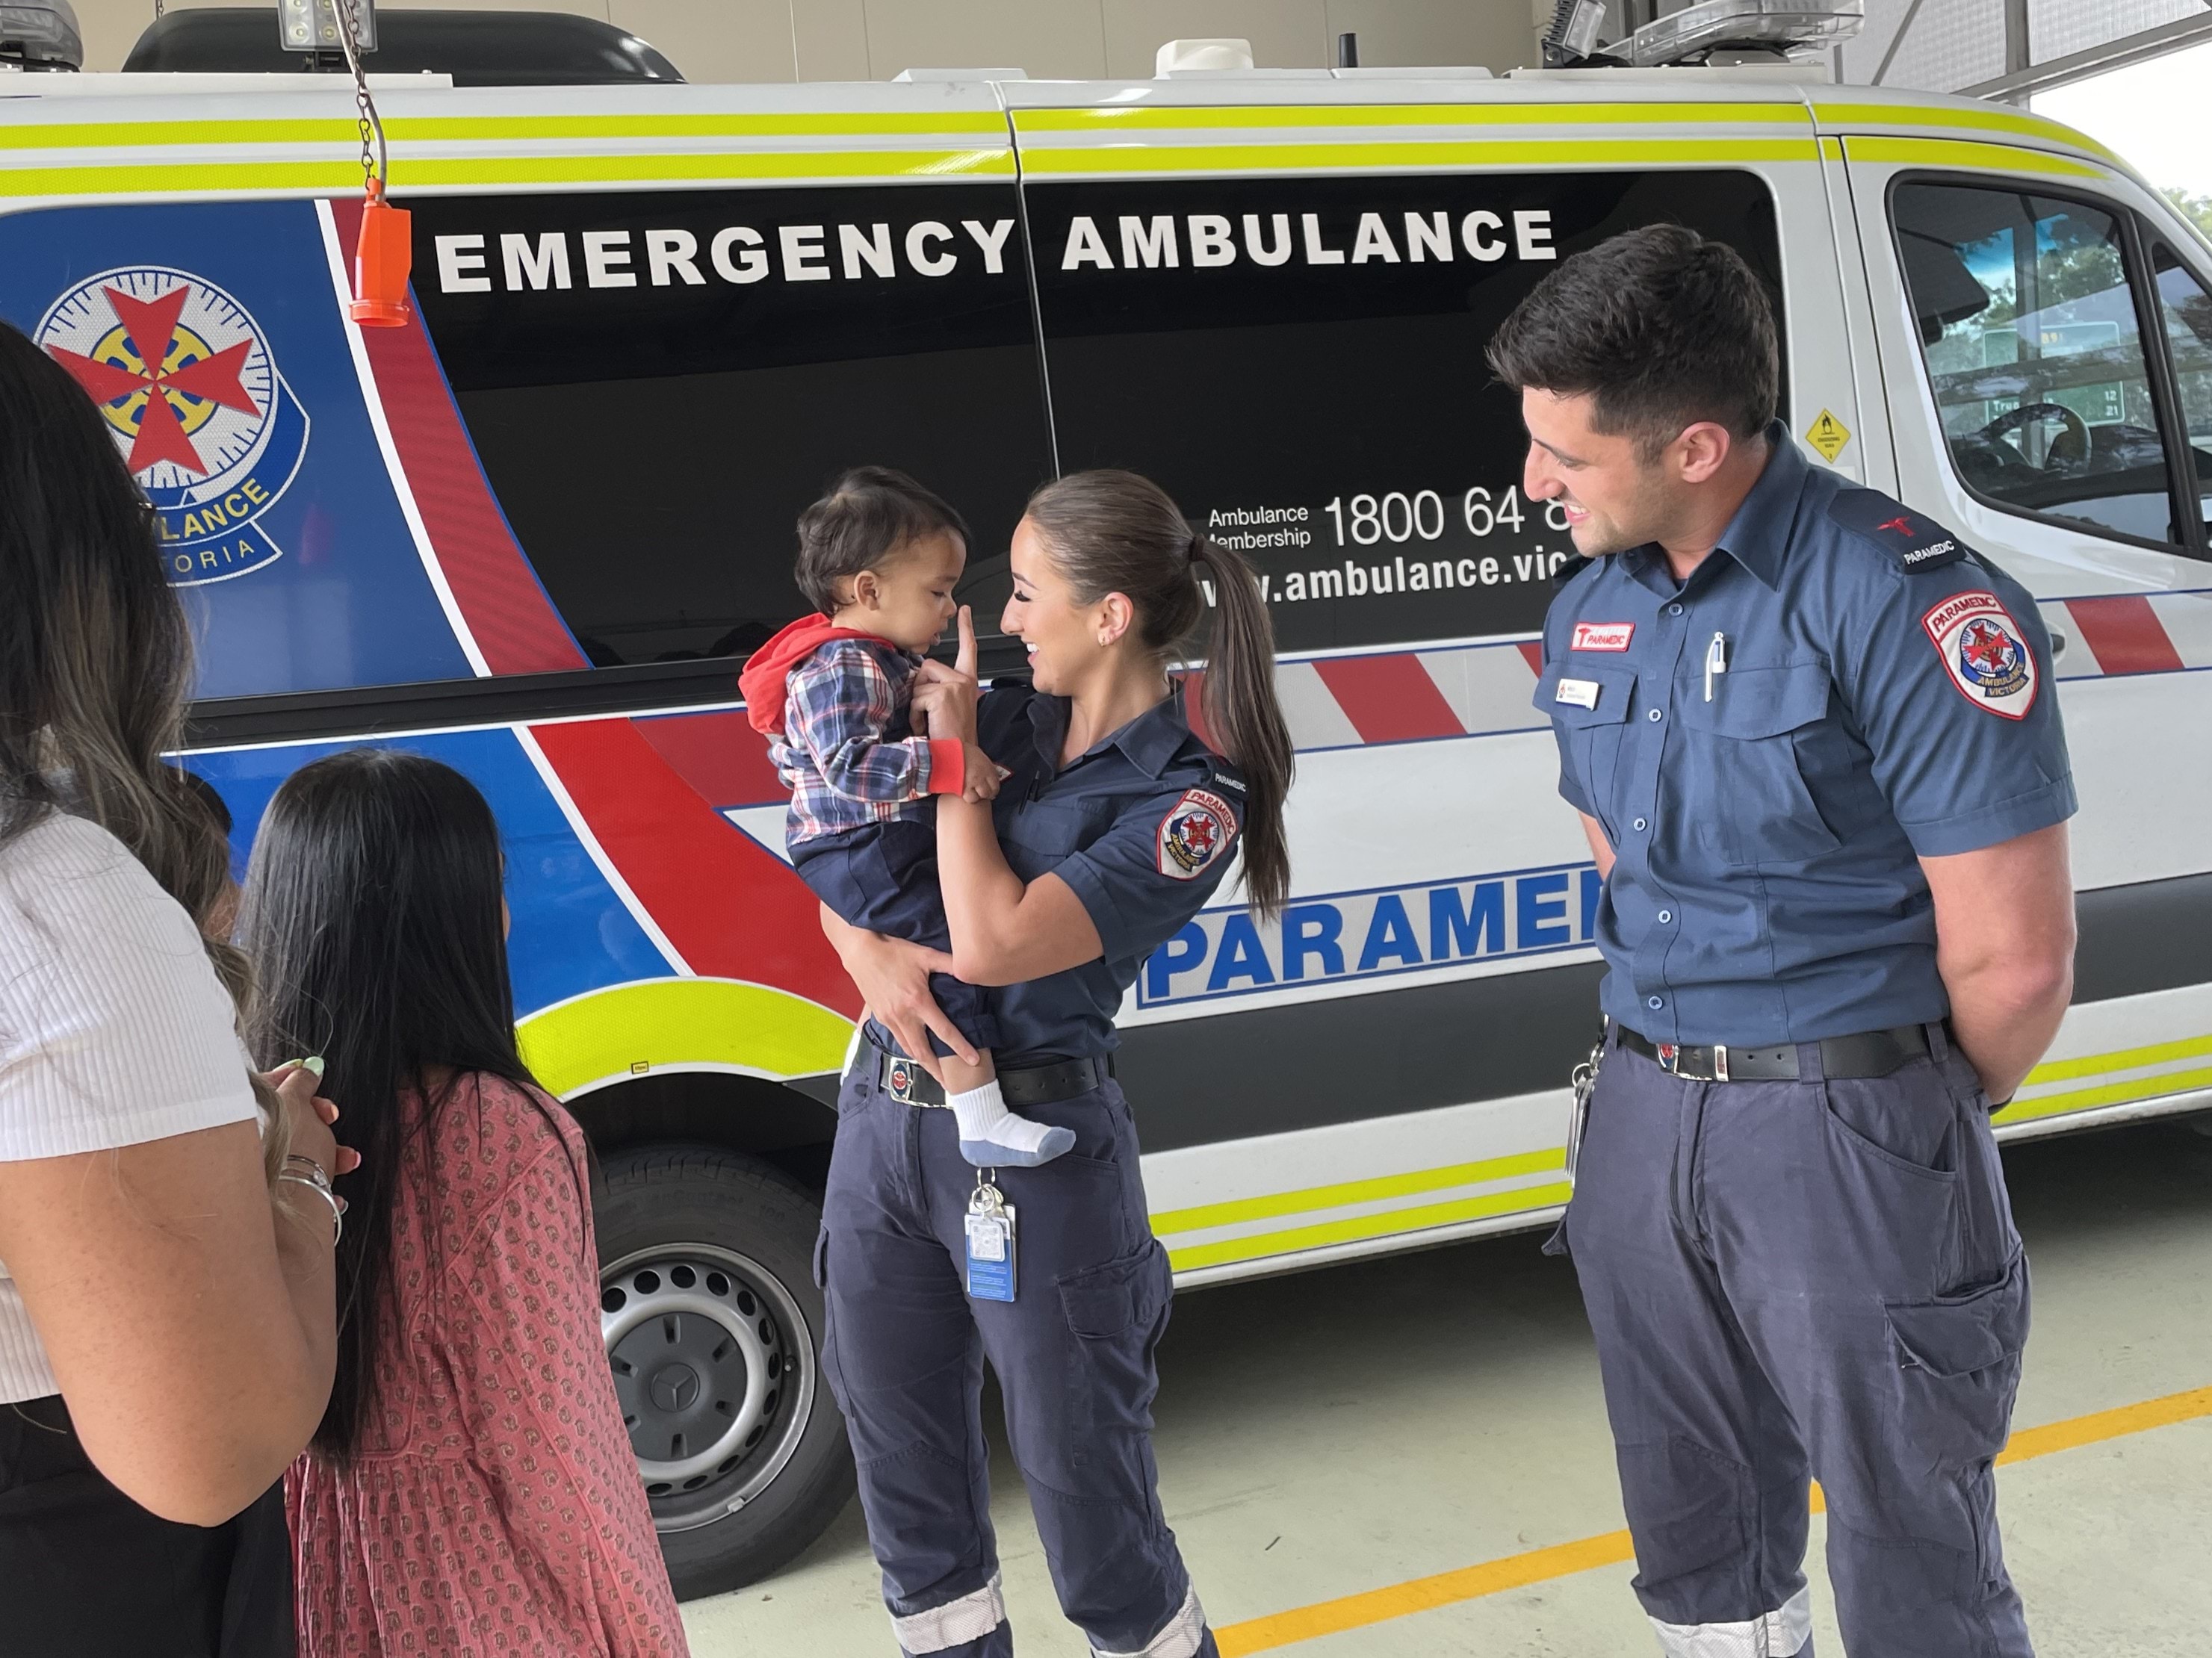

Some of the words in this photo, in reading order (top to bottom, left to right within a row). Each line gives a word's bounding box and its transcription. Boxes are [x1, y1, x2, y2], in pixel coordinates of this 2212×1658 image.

[435, 220, 1015, 293] EMERGENCY
[1061, 210, 1557, 270] AMBULANCE
[152, 478, 270, 540] LANCE
[1209, 506, 1309, 527] Ambulance
[1325, 490, 1445, 547] 1800
[1464, 485, 1525, 537] 64
[161, 539, 255, 572] ORIA
[1904, 540, 1955, 565] PARAMEDIC
[1932, 597, 1997, 633] PARAMEDIC
[1587, 635, 1626, 645] PARAMEDIC
[1977, 662, 2024, 687] AMBULANCE
[1989, 677, 2026, 696] VICTORIA
[1215, 773, 1246, 792] PARAMEDIC
[1191, 792, 1235, 834] PARAMEDIC
